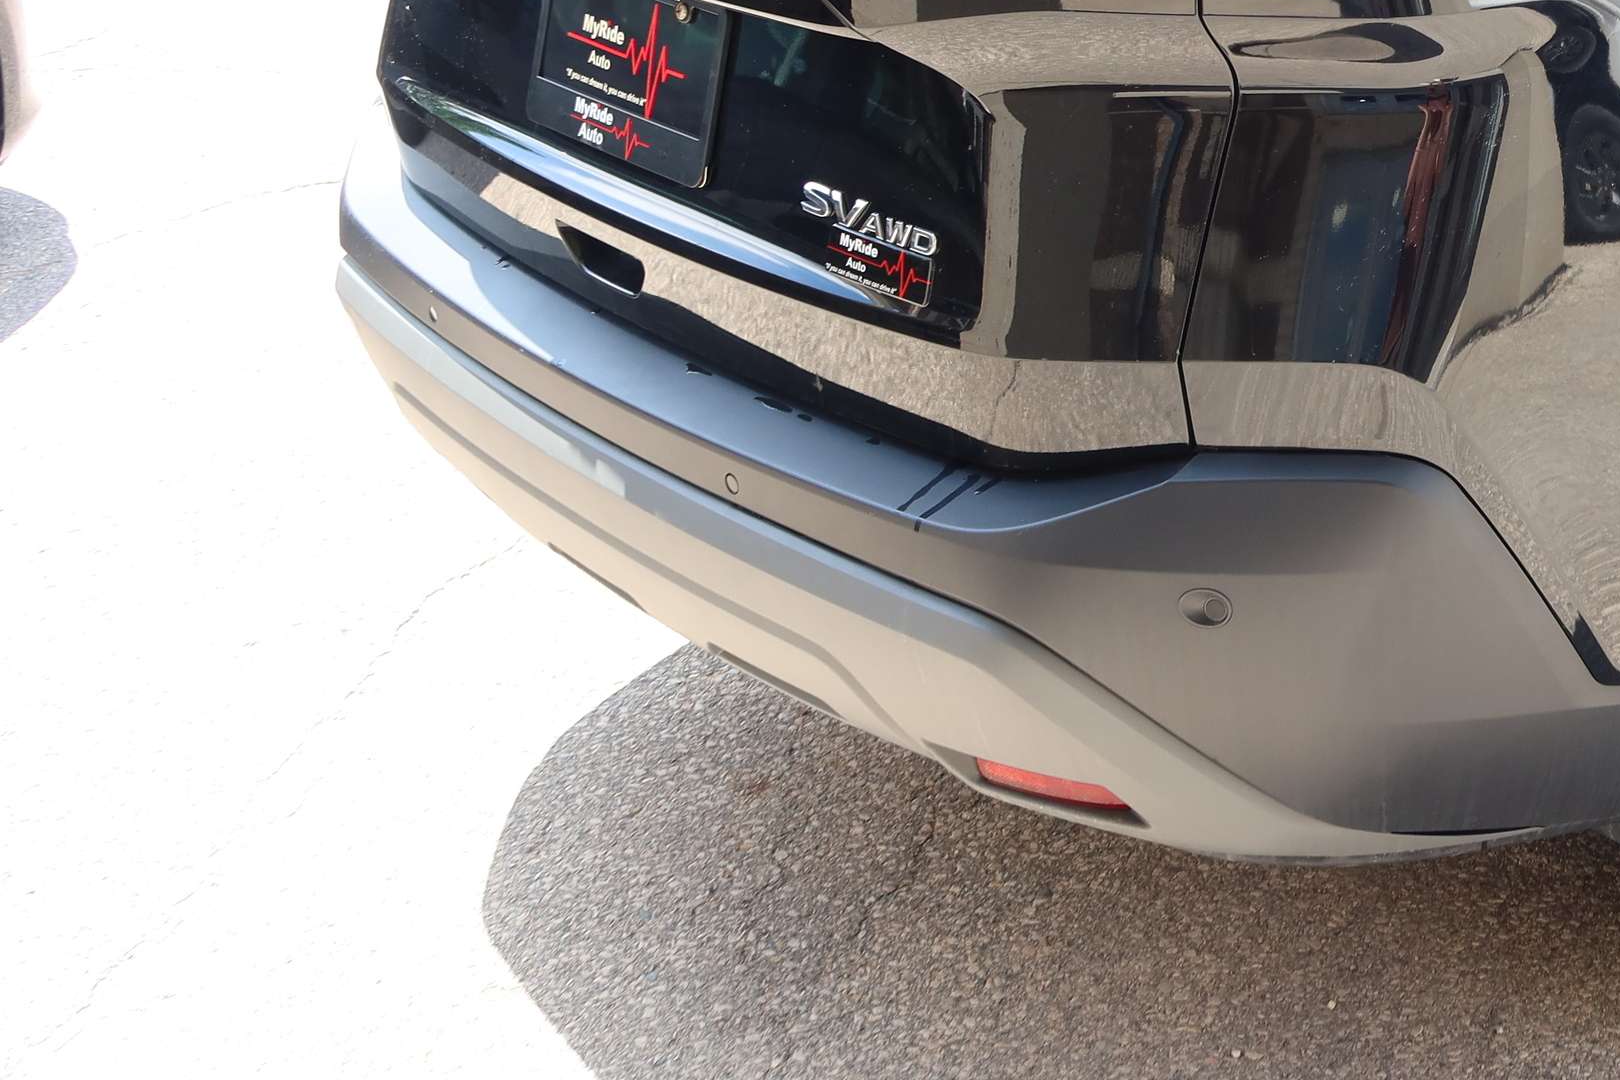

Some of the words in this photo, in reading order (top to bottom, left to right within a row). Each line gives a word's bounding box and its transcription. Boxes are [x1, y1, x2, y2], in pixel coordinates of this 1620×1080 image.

[582, 13, 625, 46] MyRide
[587, 49, 612, 71] Auto
[570, 71, 581, 81] you
[580, 74, 590, 84] can
[607, 87, 618, 96] you
[617, 90, 628, 99] can
[573, 96, 614, 126] MyRide
[577, 121, 604, 146] Auto
[801, 181, 871, 228] SV
[859, 212, 938, 256] AWD
[839, 232, 879, 258] MyRide
[846, 256, 867, 273] Auto
[862, 278, 873, 286] you
